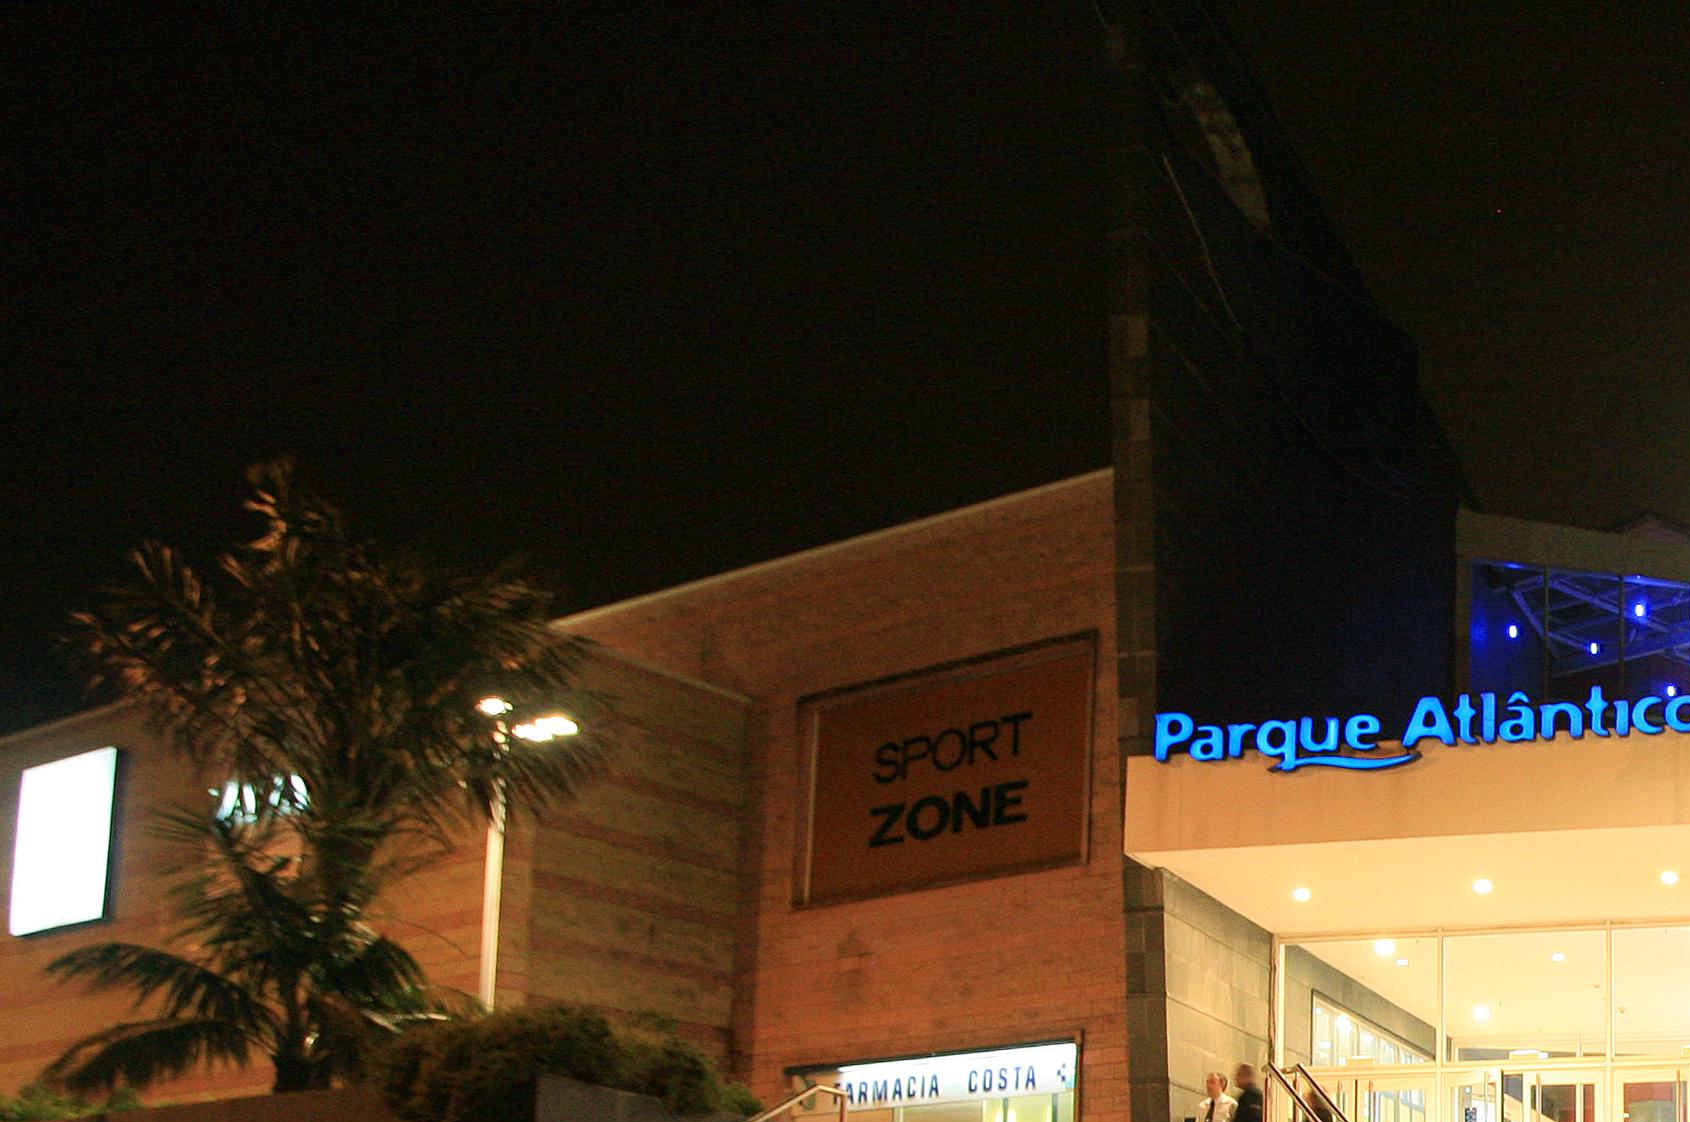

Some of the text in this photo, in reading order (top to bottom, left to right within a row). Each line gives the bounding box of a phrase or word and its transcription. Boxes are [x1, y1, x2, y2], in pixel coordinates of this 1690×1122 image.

[872, 711, 1034, 785] SPORT
[1153, 710, 1386, 772] Parque
[867, 779, 1030, 849] ZONE
[967, 1064, 1037, 1094] COSTA
